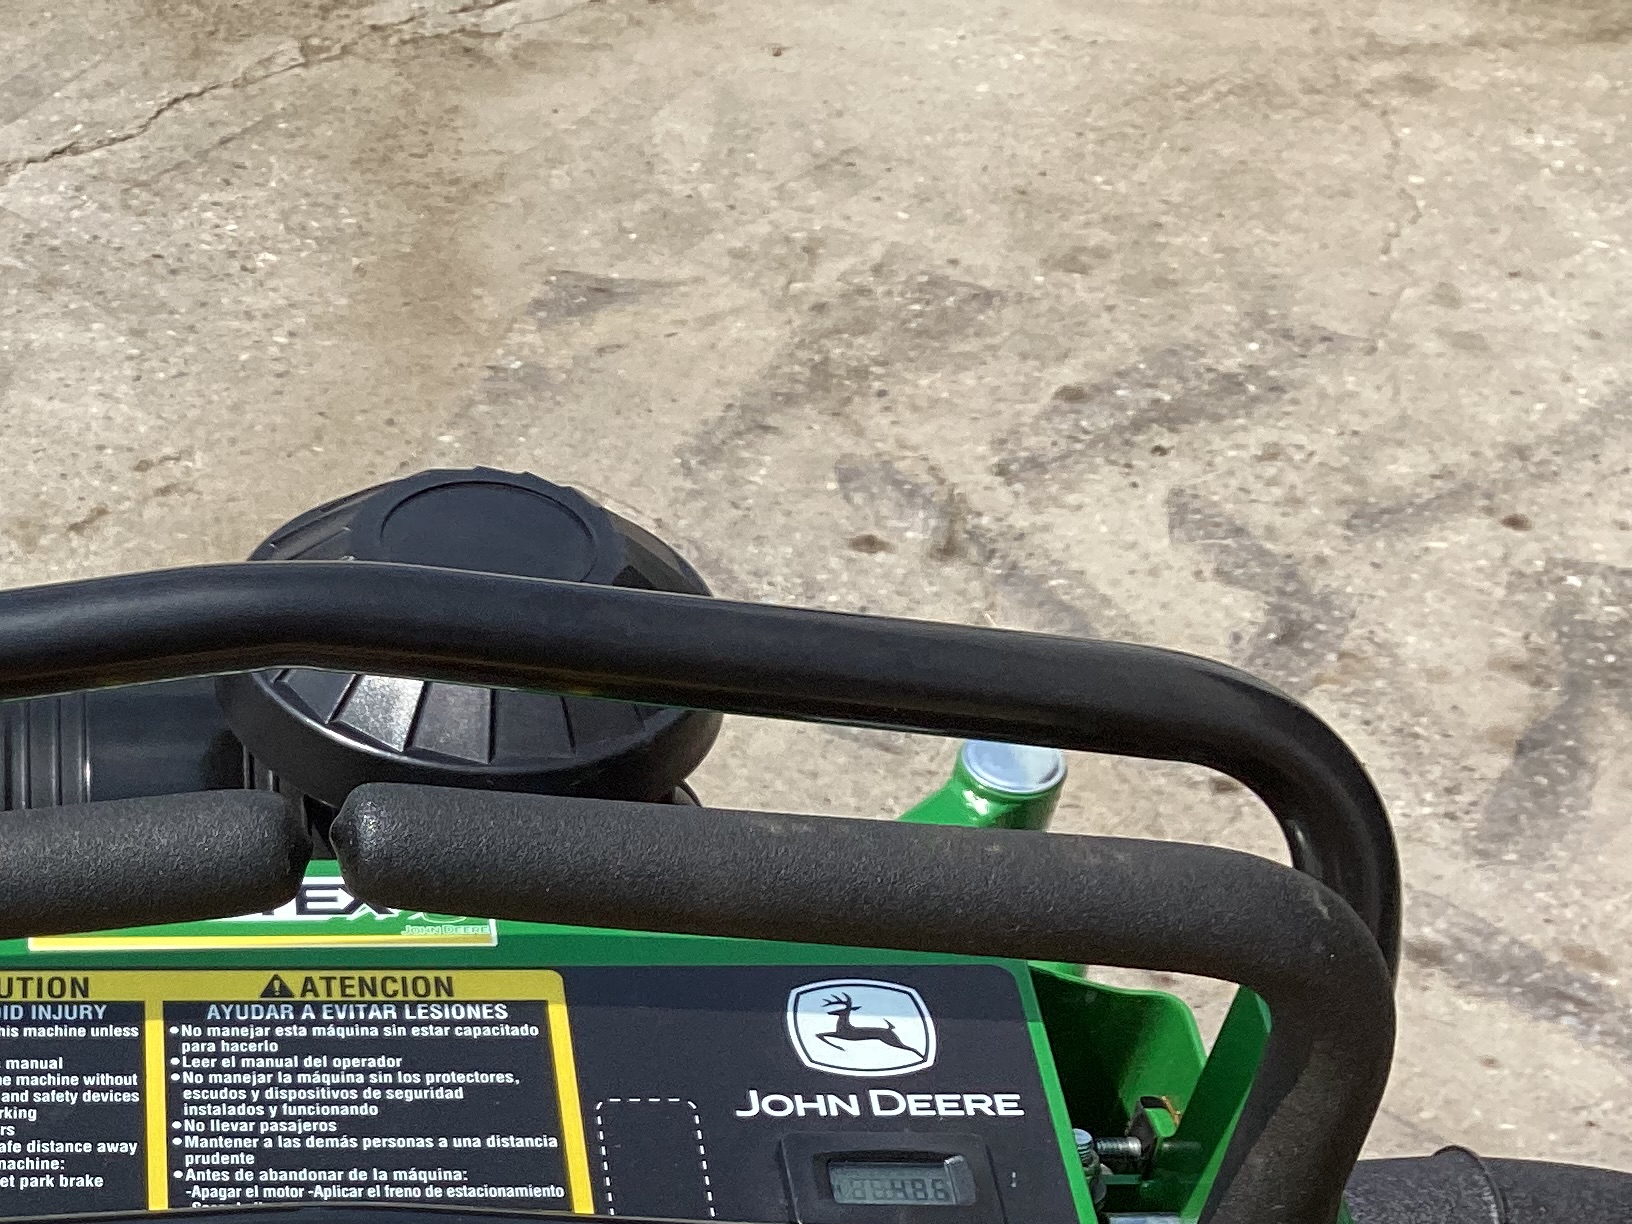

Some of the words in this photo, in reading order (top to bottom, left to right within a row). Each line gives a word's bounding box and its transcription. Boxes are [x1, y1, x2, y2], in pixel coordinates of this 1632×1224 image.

[402, 925, 441, 935] JOHN
[442, 925, 491, 935] DEERE
[300, 976, 454, 998] ATENCION
[32, 1005, 106, 1020] INJURY
[207, 1004, 294, 1020] AYUDAR
[301, 1004, 315, 1019] A
[322, 1004, 397, 1019] EVITAR
[405, 1004, 508, 1019] LESIONES
[182, 1042, 216, 1054] para
[221, 1040, 278, 1052] hacerlo
[6, 1057, 62, 1069] manual
[182, 1056, 217, 1068] Leer
[222, 1056, 235, 1067] el
[242, 1056, 298, 1067] manual
[304, 1056, 327, 1067] del
[333, 1056, 402, 1070] operador
[16, 1074, 79, 1086] machine
[83, 1074, 137, 1085] without
[1, 1090, 28, 1102] and
[33, 1090, 78, 1105] safety
[83, 1090, 139, 1102] devices
[183, 1087, 246, 1099] escudos
[251, 1090, 260, 1102] y
[265, 1087, 358, 1102] dispositivos
[363, 1087, 381, 1099] de
[386, 1087, 463, 1102] seguridad
[184, 1103, 264, 1115] instalados
[269, 1106, 277, 1118] y
[282, 1103, 378, 1115] funcionando
[736, 1090, 860, 1116] JOHN
[869, 1090, 1024, 1116] DEERE
[184, 1119, 205, 1132] No
[211, 1119, 255, 1131] llevar
[260, 1119, 337, 1134] pasajeros
[27, 1140, 92, 1153] distance
[97, 1142, 137, 1155] away
[186, 1152, 254, 1167] prudente
[20, 1175, 54, 1190] park
[60, 1175, 103, 1187] brake
